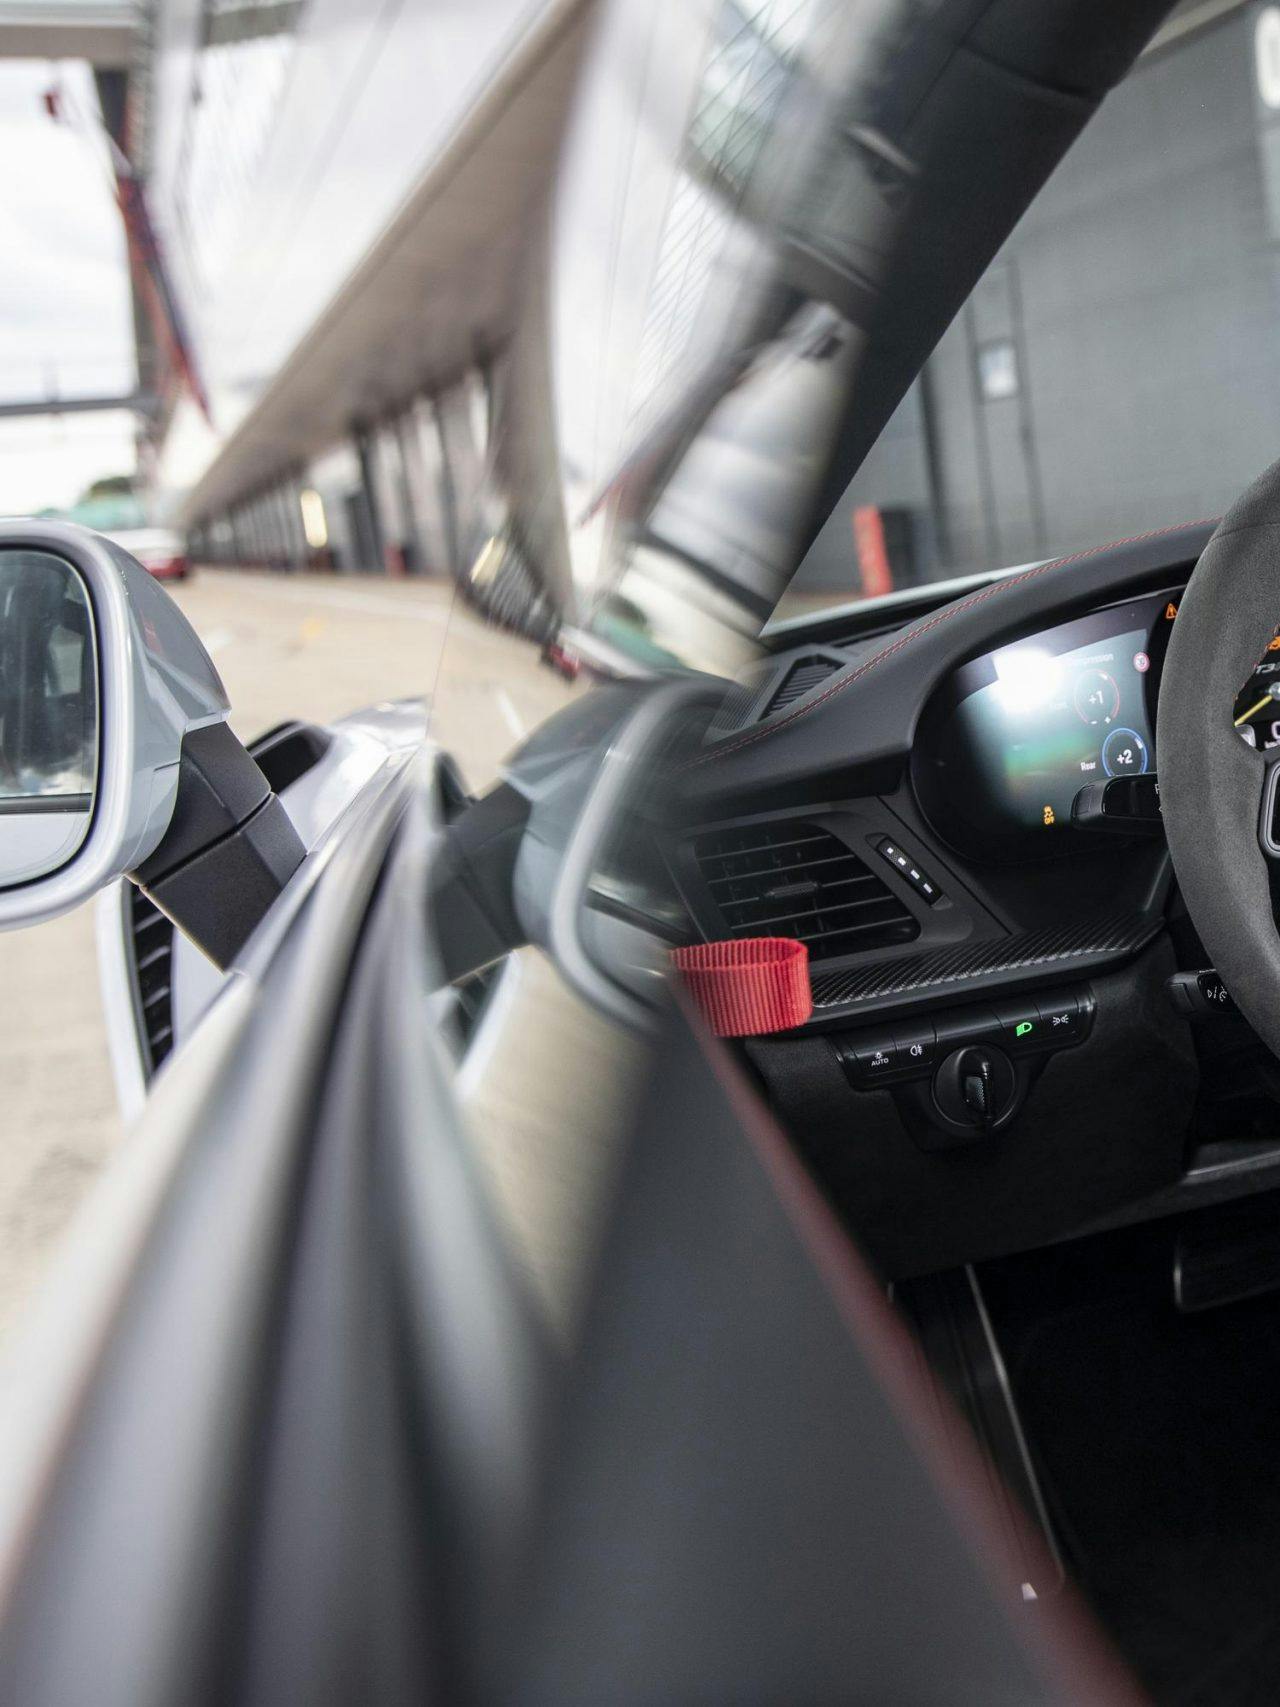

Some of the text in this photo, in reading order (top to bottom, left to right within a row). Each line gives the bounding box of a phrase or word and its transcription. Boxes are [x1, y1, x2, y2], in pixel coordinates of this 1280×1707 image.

[1088, 690, 1104, 705] +1
[1117, 749, 1133, 764] +2
[1080, 760, 1096, 771] Rear
[871, 1057, 889, 1067] AUTO
